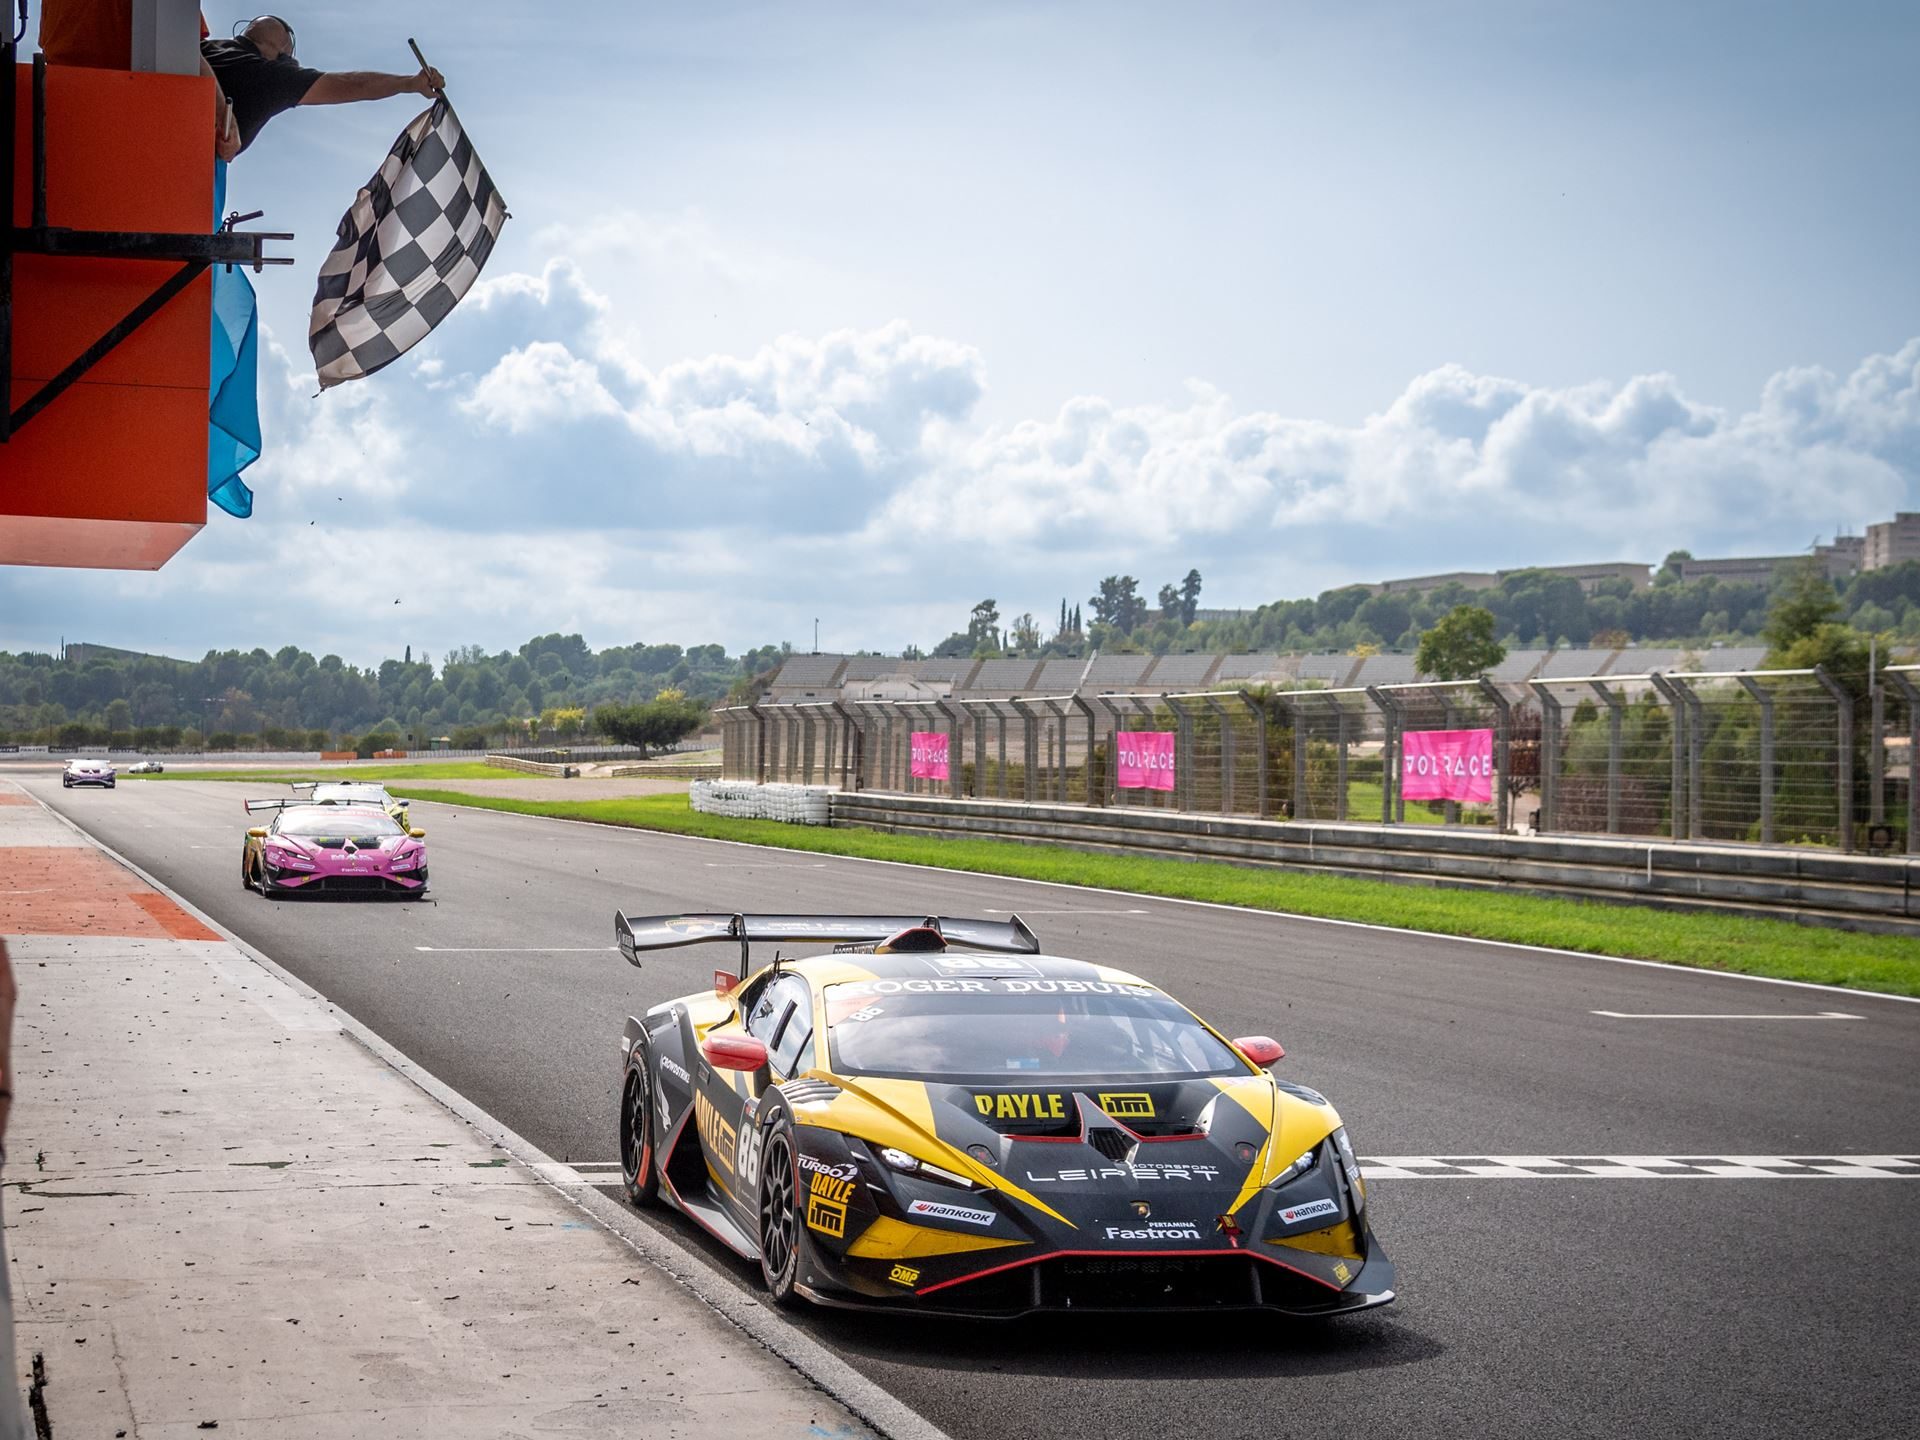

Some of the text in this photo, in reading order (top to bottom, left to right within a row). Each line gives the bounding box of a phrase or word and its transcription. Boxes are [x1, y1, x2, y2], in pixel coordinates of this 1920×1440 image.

[911, 747, 948, 763] VOLRACE
[1119, 751, 1174, 770] VOLRACE
[1405, 755, 1489, 776] VOLRACE
[1003, 979, 1153, 997] DUBUIS
[849, 1006, 885, 1022] 86
[974, 1094, 1066, 1119] DAYLE
[738, 1122, 760, 1186] 86
[797, 1157, 844, 1179] TURBO
[1026, 1168, 1220, 1182] LEIPERT
[1129, 1163, 1217, 1171] MOTORSPORT
[812, 1172, 856, 1204] DAYLE
[1105, 1227, 1201, 1240] Fastron
[889, 1267, 920, 1284] OMP
